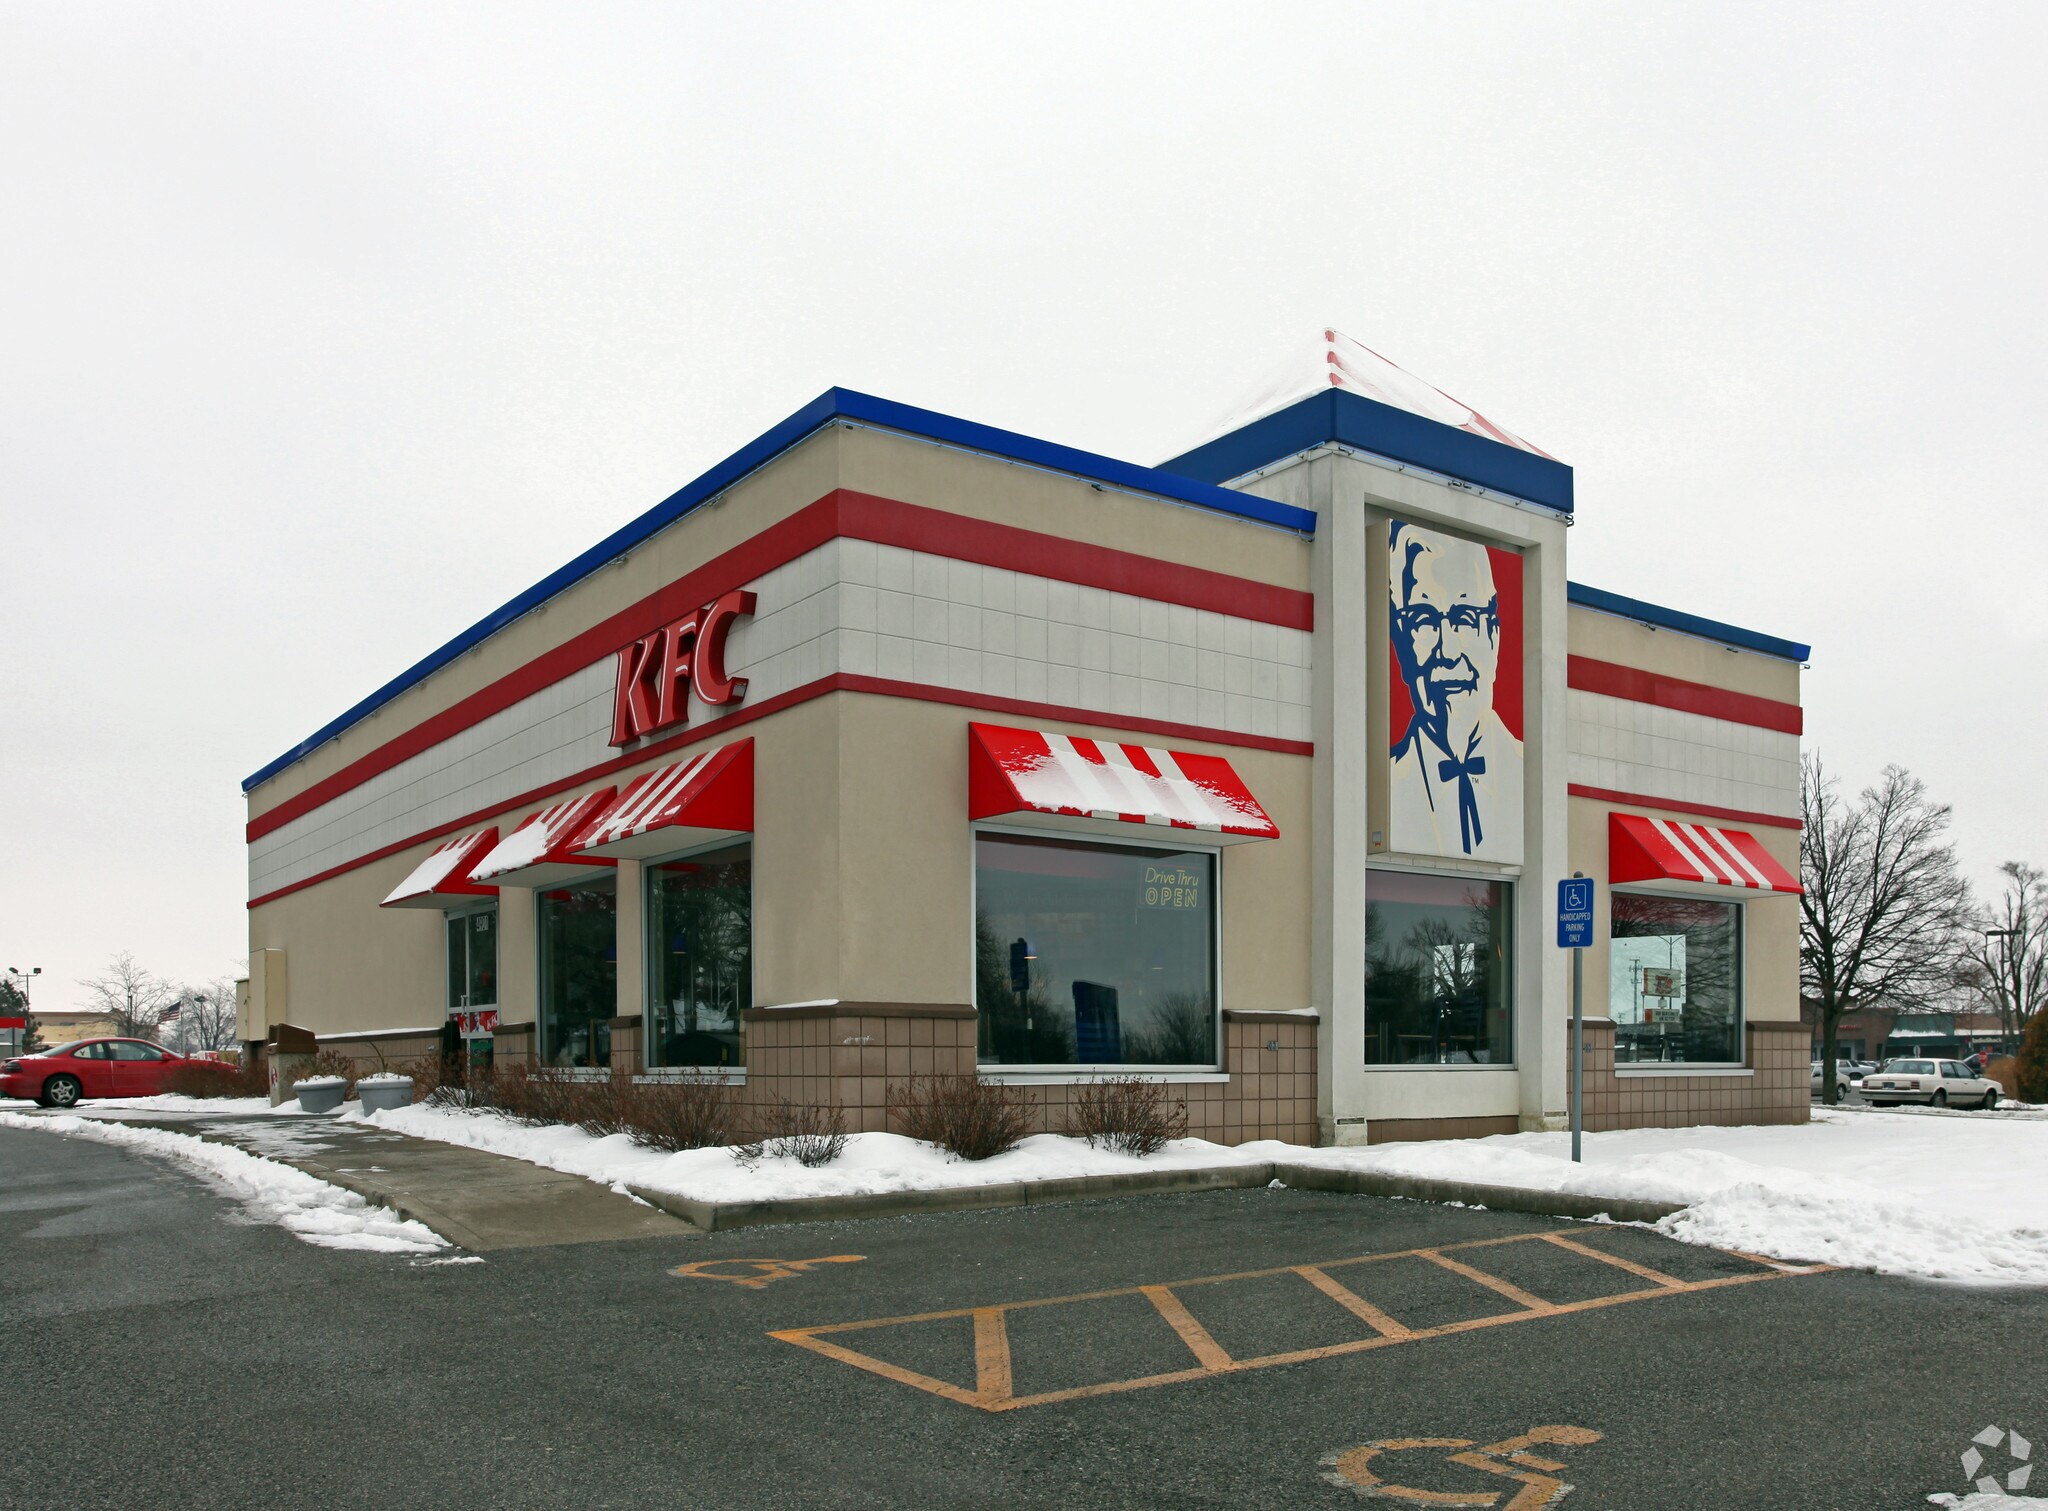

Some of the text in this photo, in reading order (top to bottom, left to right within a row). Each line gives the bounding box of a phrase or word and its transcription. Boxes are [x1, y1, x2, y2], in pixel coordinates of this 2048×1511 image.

[608, 590, 757, 747] KFC
[1145, 867, 1199, 886] Drive Thru
[1145, 887, 1198, 907] OPEN
[1560, 913, 1591, 921] HANDICAPPED
[1566, 923, 1584, 931] PARKING
[1569, 934, 1580, 942] ONLY
